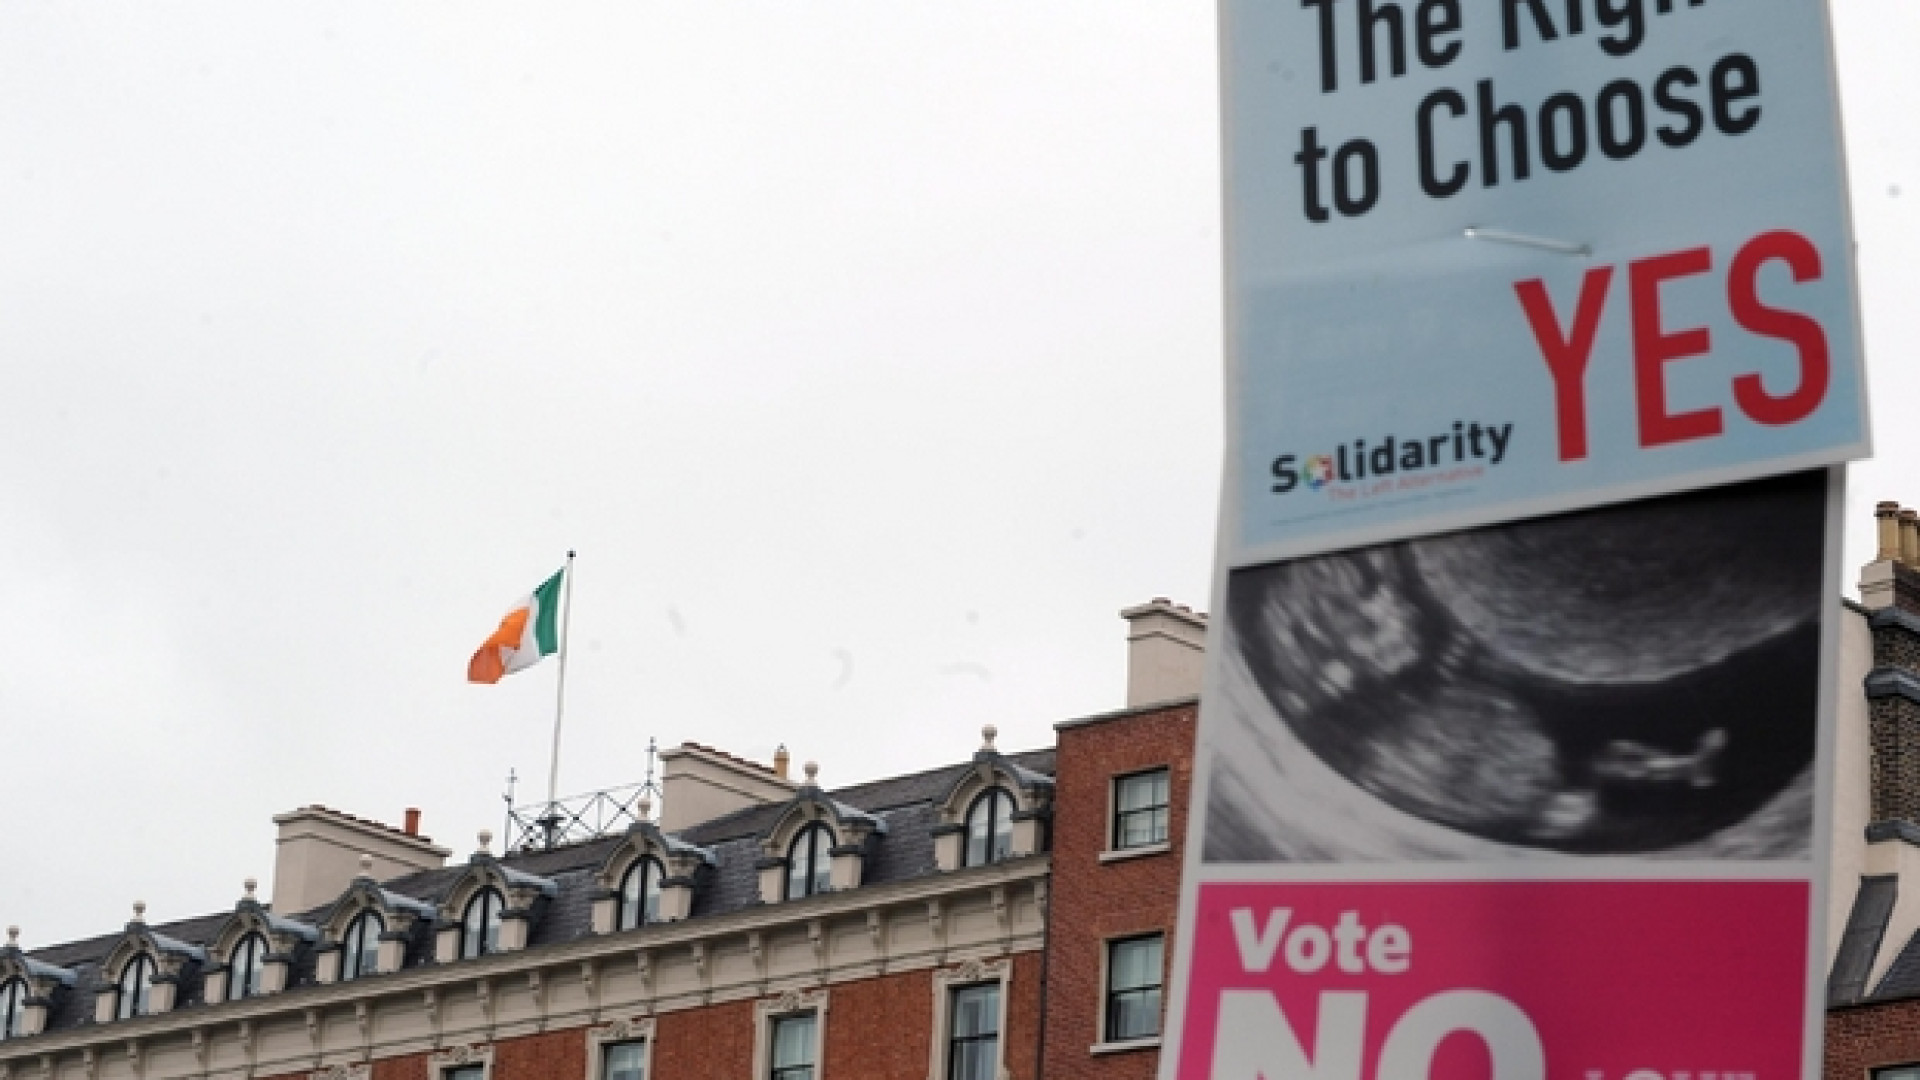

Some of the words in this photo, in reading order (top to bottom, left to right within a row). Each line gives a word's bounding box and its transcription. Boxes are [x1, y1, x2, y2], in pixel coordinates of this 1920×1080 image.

[1301, 0, 1462, 92] The
[1295, 126, 1379, 223] to
[1416, 52, 1762, 198] Choose
[1513, 228, 1829, 462] YES
[1270, 420, 1514, 494] Solidarity
[1229, 906, 1413, 975] Vote
